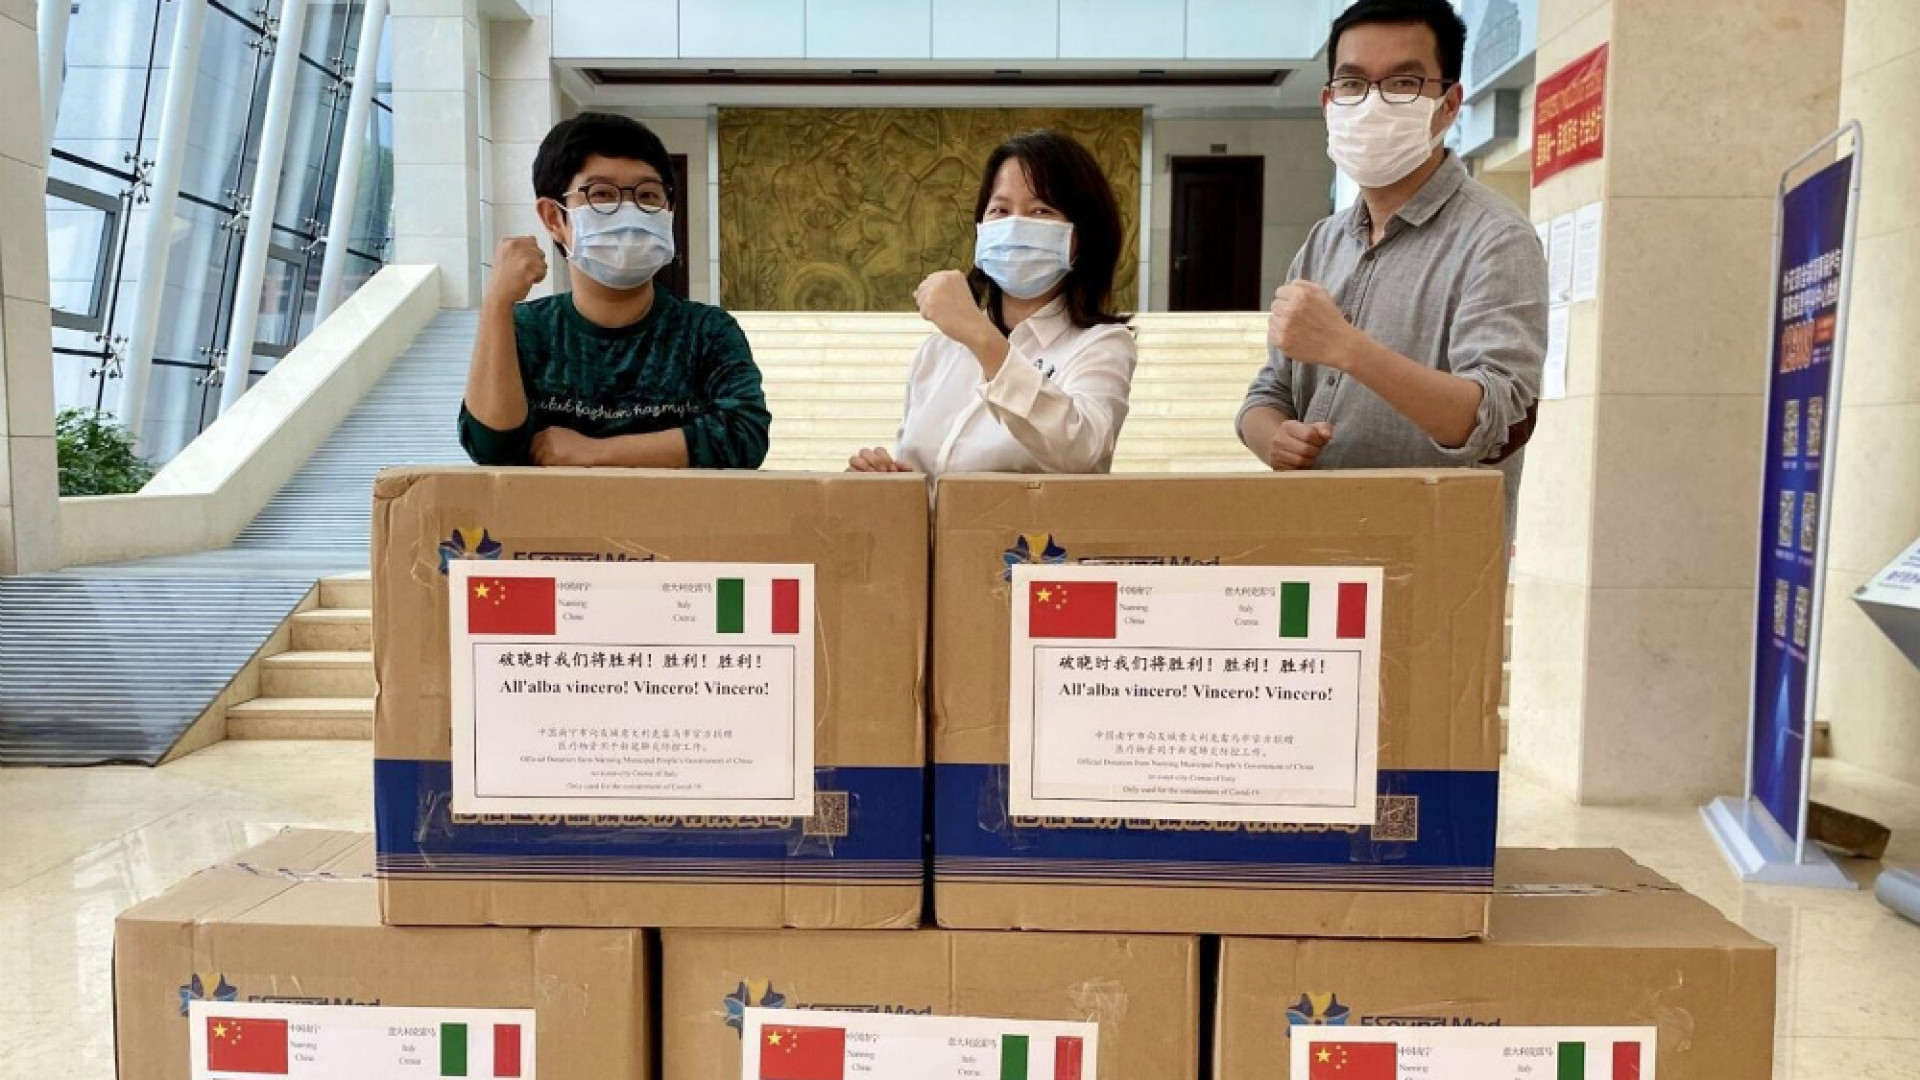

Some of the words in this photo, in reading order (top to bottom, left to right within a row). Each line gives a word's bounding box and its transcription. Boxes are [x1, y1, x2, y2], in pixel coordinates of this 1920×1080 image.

[499, 680, 561, 694] All'alba
[566, 680, 629, 695] vincero!
[634, 680, 699, 696] Vincero!
[704, 681, 769, 696] Vincero!
[1059, 683, 1120, 697] All'alba
[1124, 683, 1187, 699] vincero!
[1193, 685, 1259, 700] Vincero!
[1265, 686, 1333, 701] Vincero!
